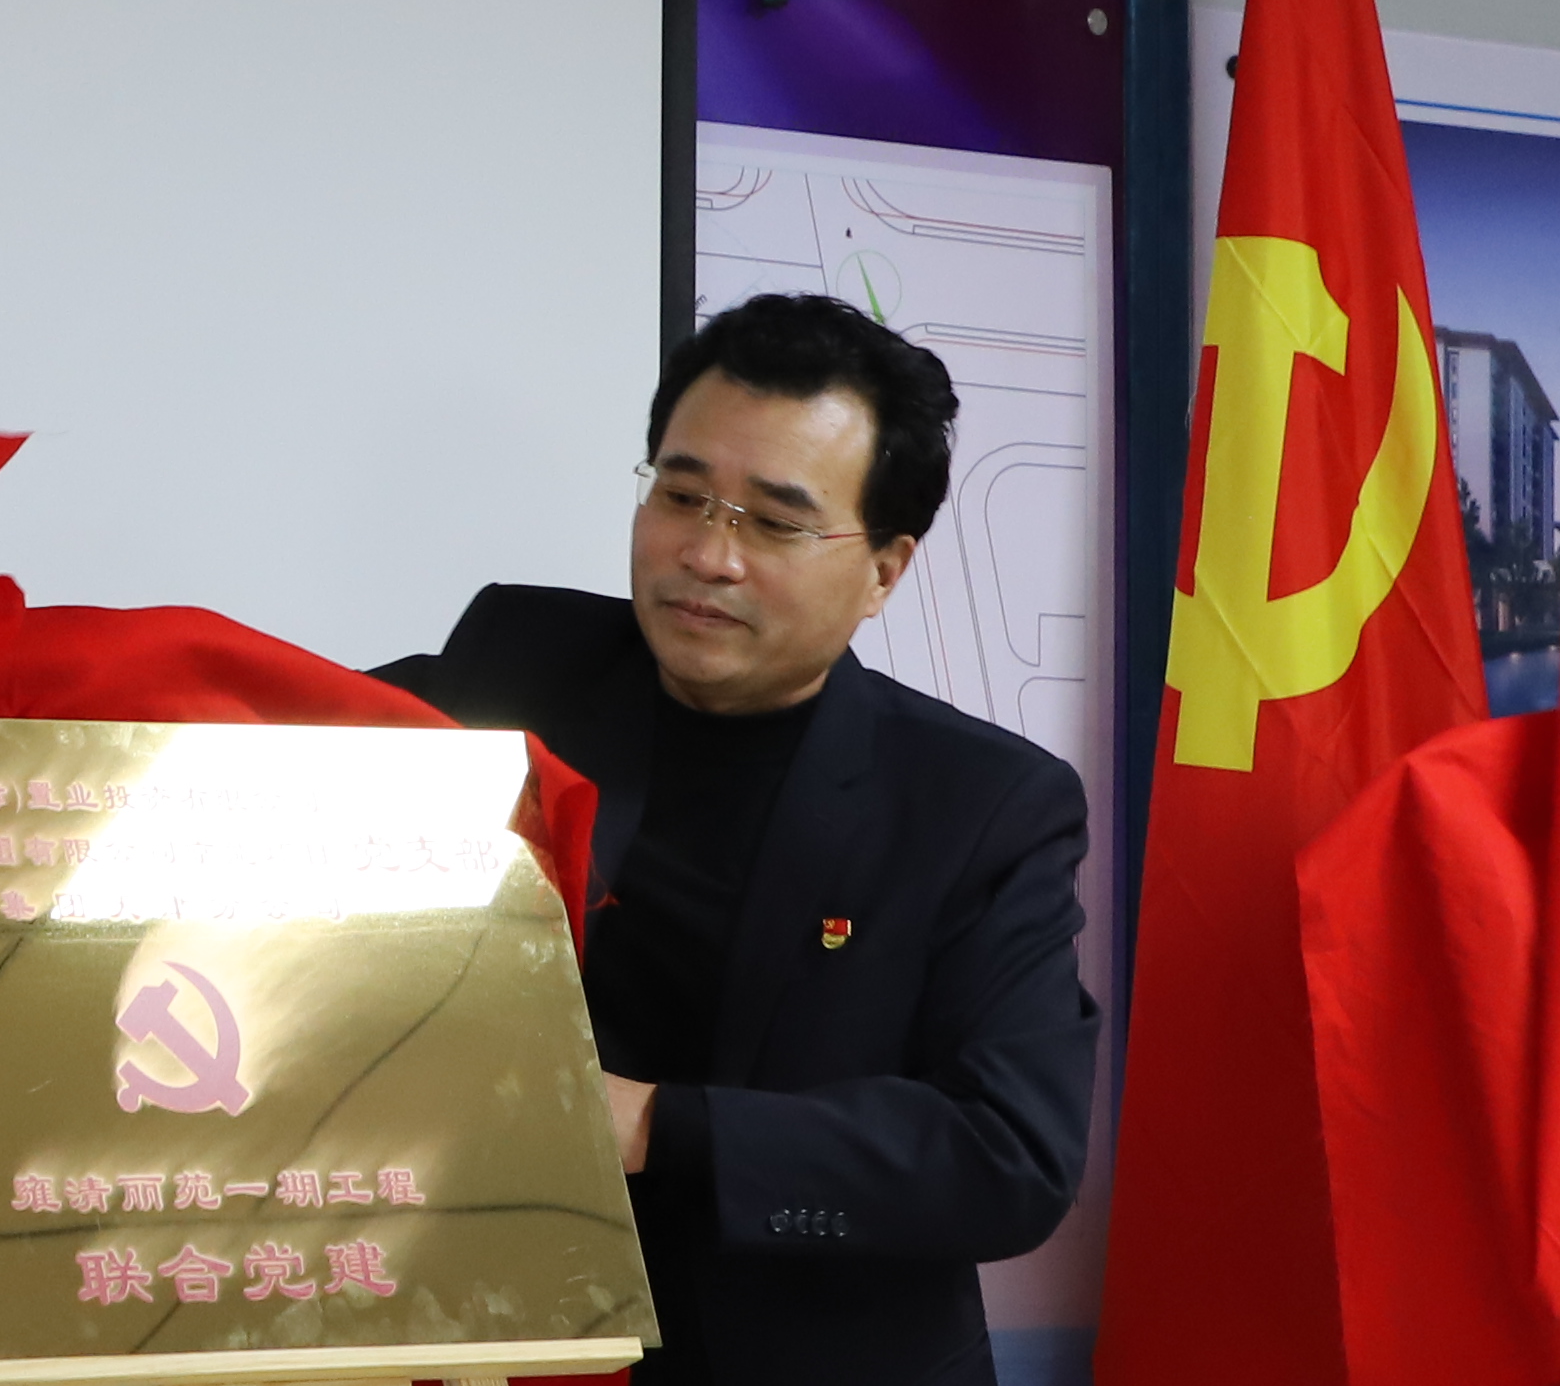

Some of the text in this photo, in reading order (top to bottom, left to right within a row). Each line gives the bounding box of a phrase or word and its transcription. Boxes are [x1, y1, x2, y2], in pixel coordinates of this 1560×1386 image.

[11, 1169, 426, 1213] 雍清丽苑一期工程
[75, 1239, 397, 1305] 联合党建
